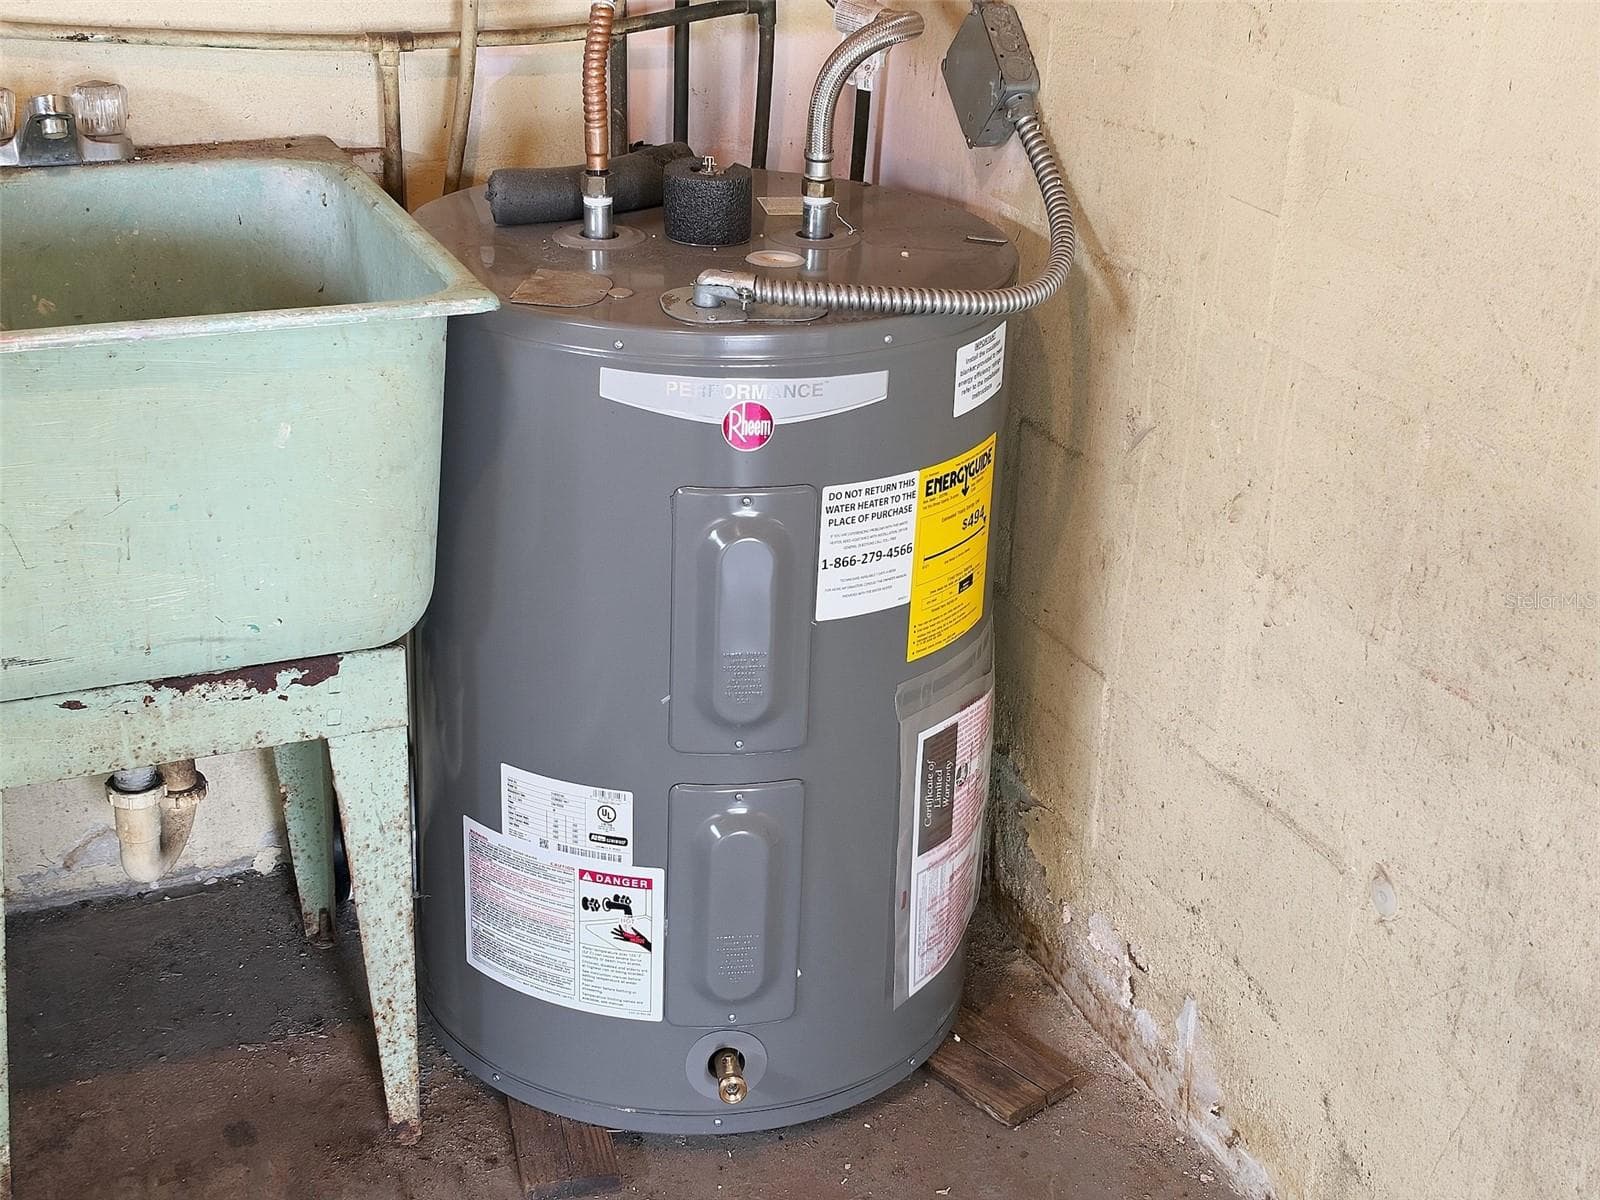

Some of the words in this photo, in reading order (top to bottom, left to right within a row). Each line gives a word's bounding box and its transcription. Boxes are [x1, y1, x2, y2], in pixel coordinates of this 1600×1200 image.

[728, 401, 771, 443] Rheem
[828, 491, 842, 501] DO
[844, 489, 863, 499] NOT
[865, 483, 897, 496] RETURN
[898, 478, 915, 490] THIS
[825, 503, 855, 514] WATER
[857, 496, 889, 510] HEATER
[890, 494, 901, 504] TO
[902, 490, 916, 500] THE
[828, 516, 856, 527] PLACE
[858, 513, 870, 523] OF
[871, 504, 913, 520] PURCHASE
[821, 542, 913, 570] 1-866-279-4566
[926, 759, 937, 771] of
[933, 769, 943, 808] Limited
[942, 760, 954, 808] Warranty
[924, 773, 934, 827] Certificate
[601, 808, 612, 820] UL
[596, 874, 648, 888] DANGER
